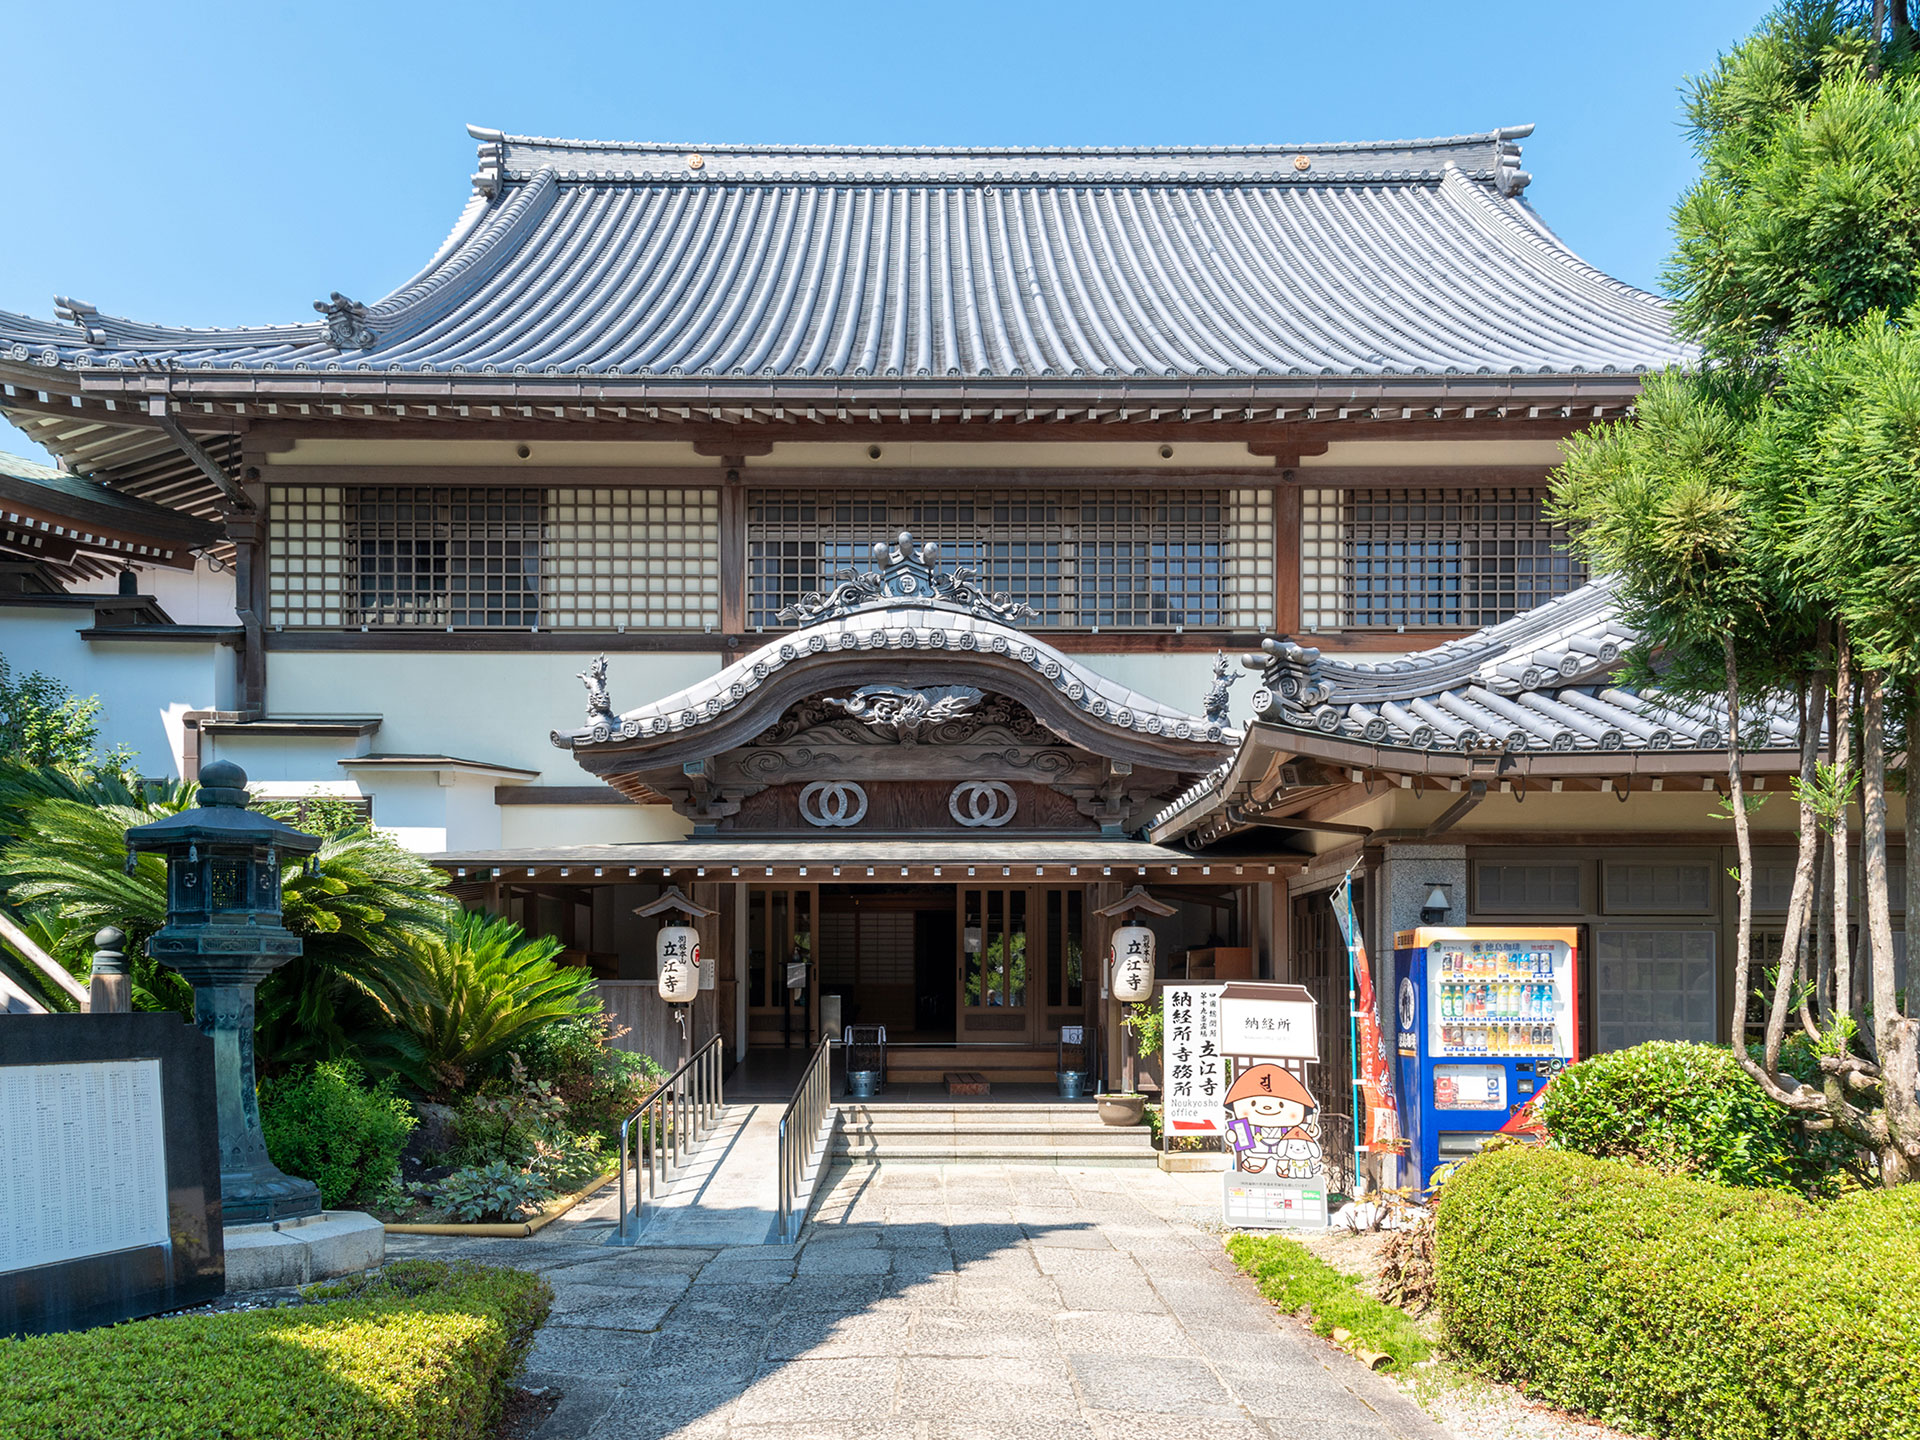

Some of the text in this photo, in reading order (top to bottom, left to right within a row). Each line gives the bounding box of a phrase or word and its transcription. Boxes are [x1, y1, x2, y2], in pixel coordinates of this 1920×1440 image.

[663, 941, 678, 993] 立江寺
[1126, 939, 1142, 992] 立江寺
[1244, 1016, 1292, 1032] 納経所
[1198, 1040, 1219, 1096] 立江寺
[1171, 1098, 1219, 1109] Noukyosho
[1171, 1107, 1198, 1117] office
